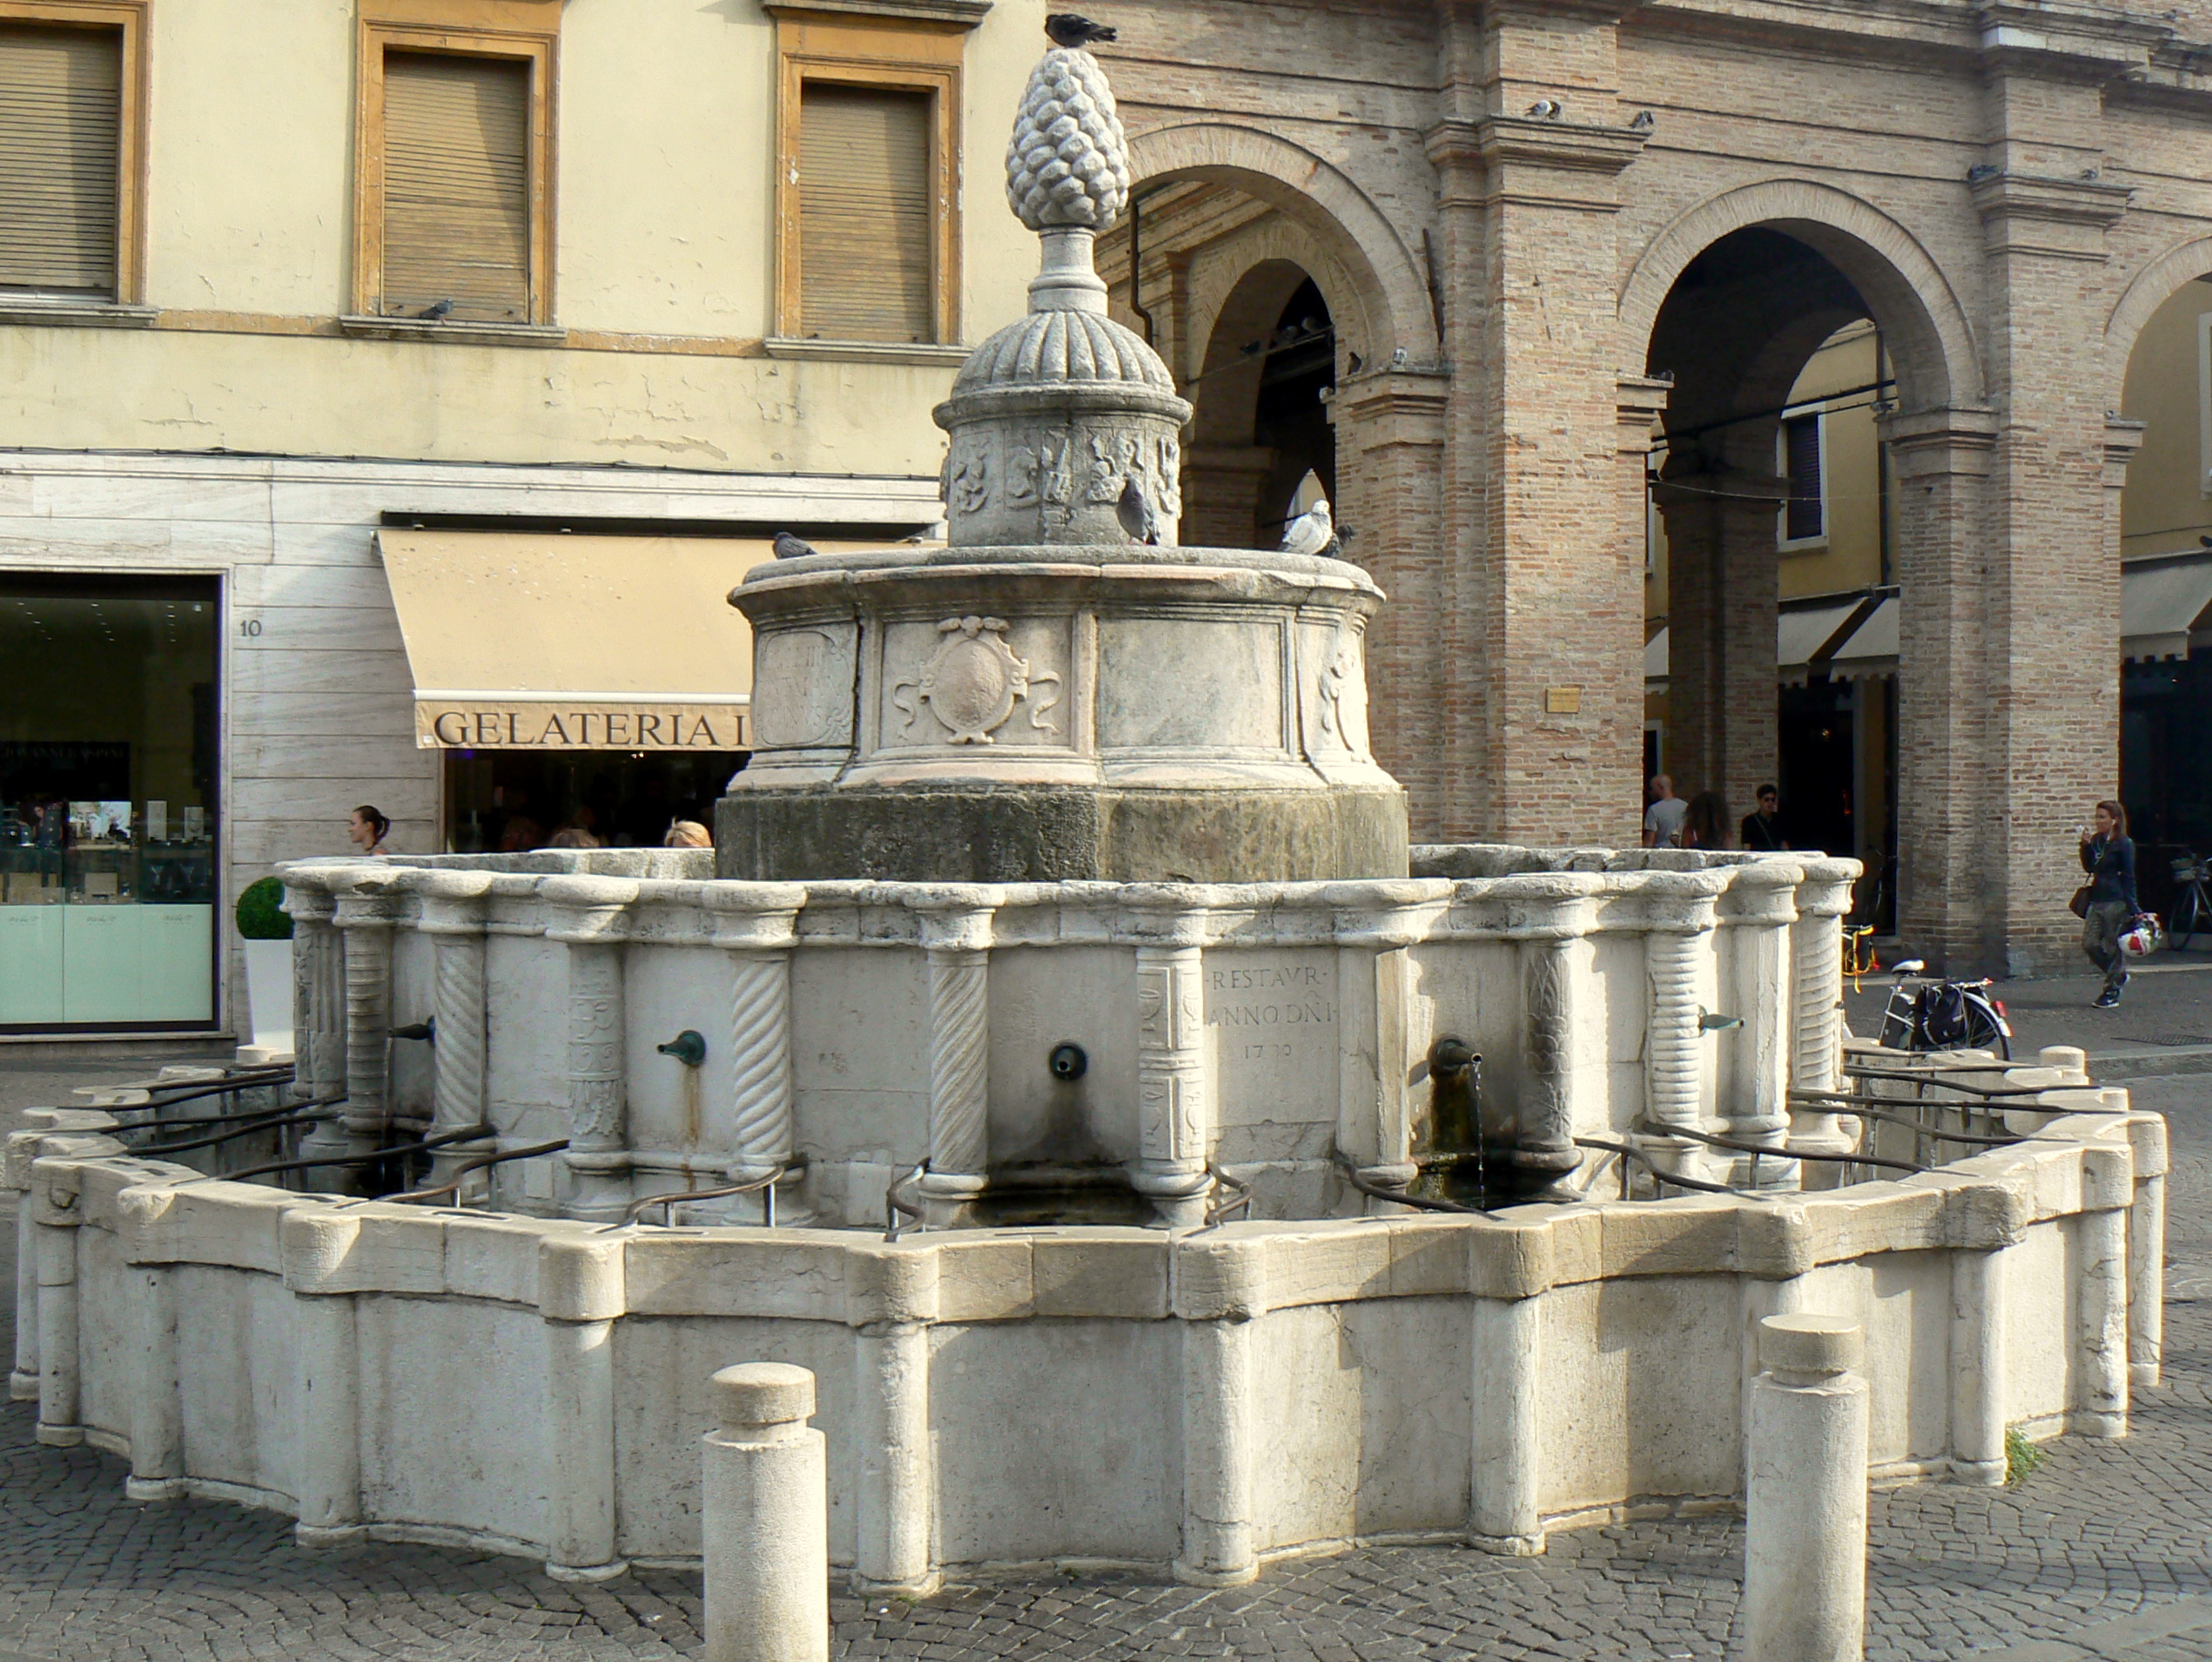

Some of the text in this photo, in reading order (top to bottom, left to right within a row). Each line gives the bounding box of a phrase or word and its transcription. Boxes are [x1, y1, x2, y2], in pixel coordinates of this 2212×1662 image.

[240, 619, 262, 636] 10
[433, 710, 721, 748] GELATERIA
[1208, 1004, 1279, 1026] ANNO
